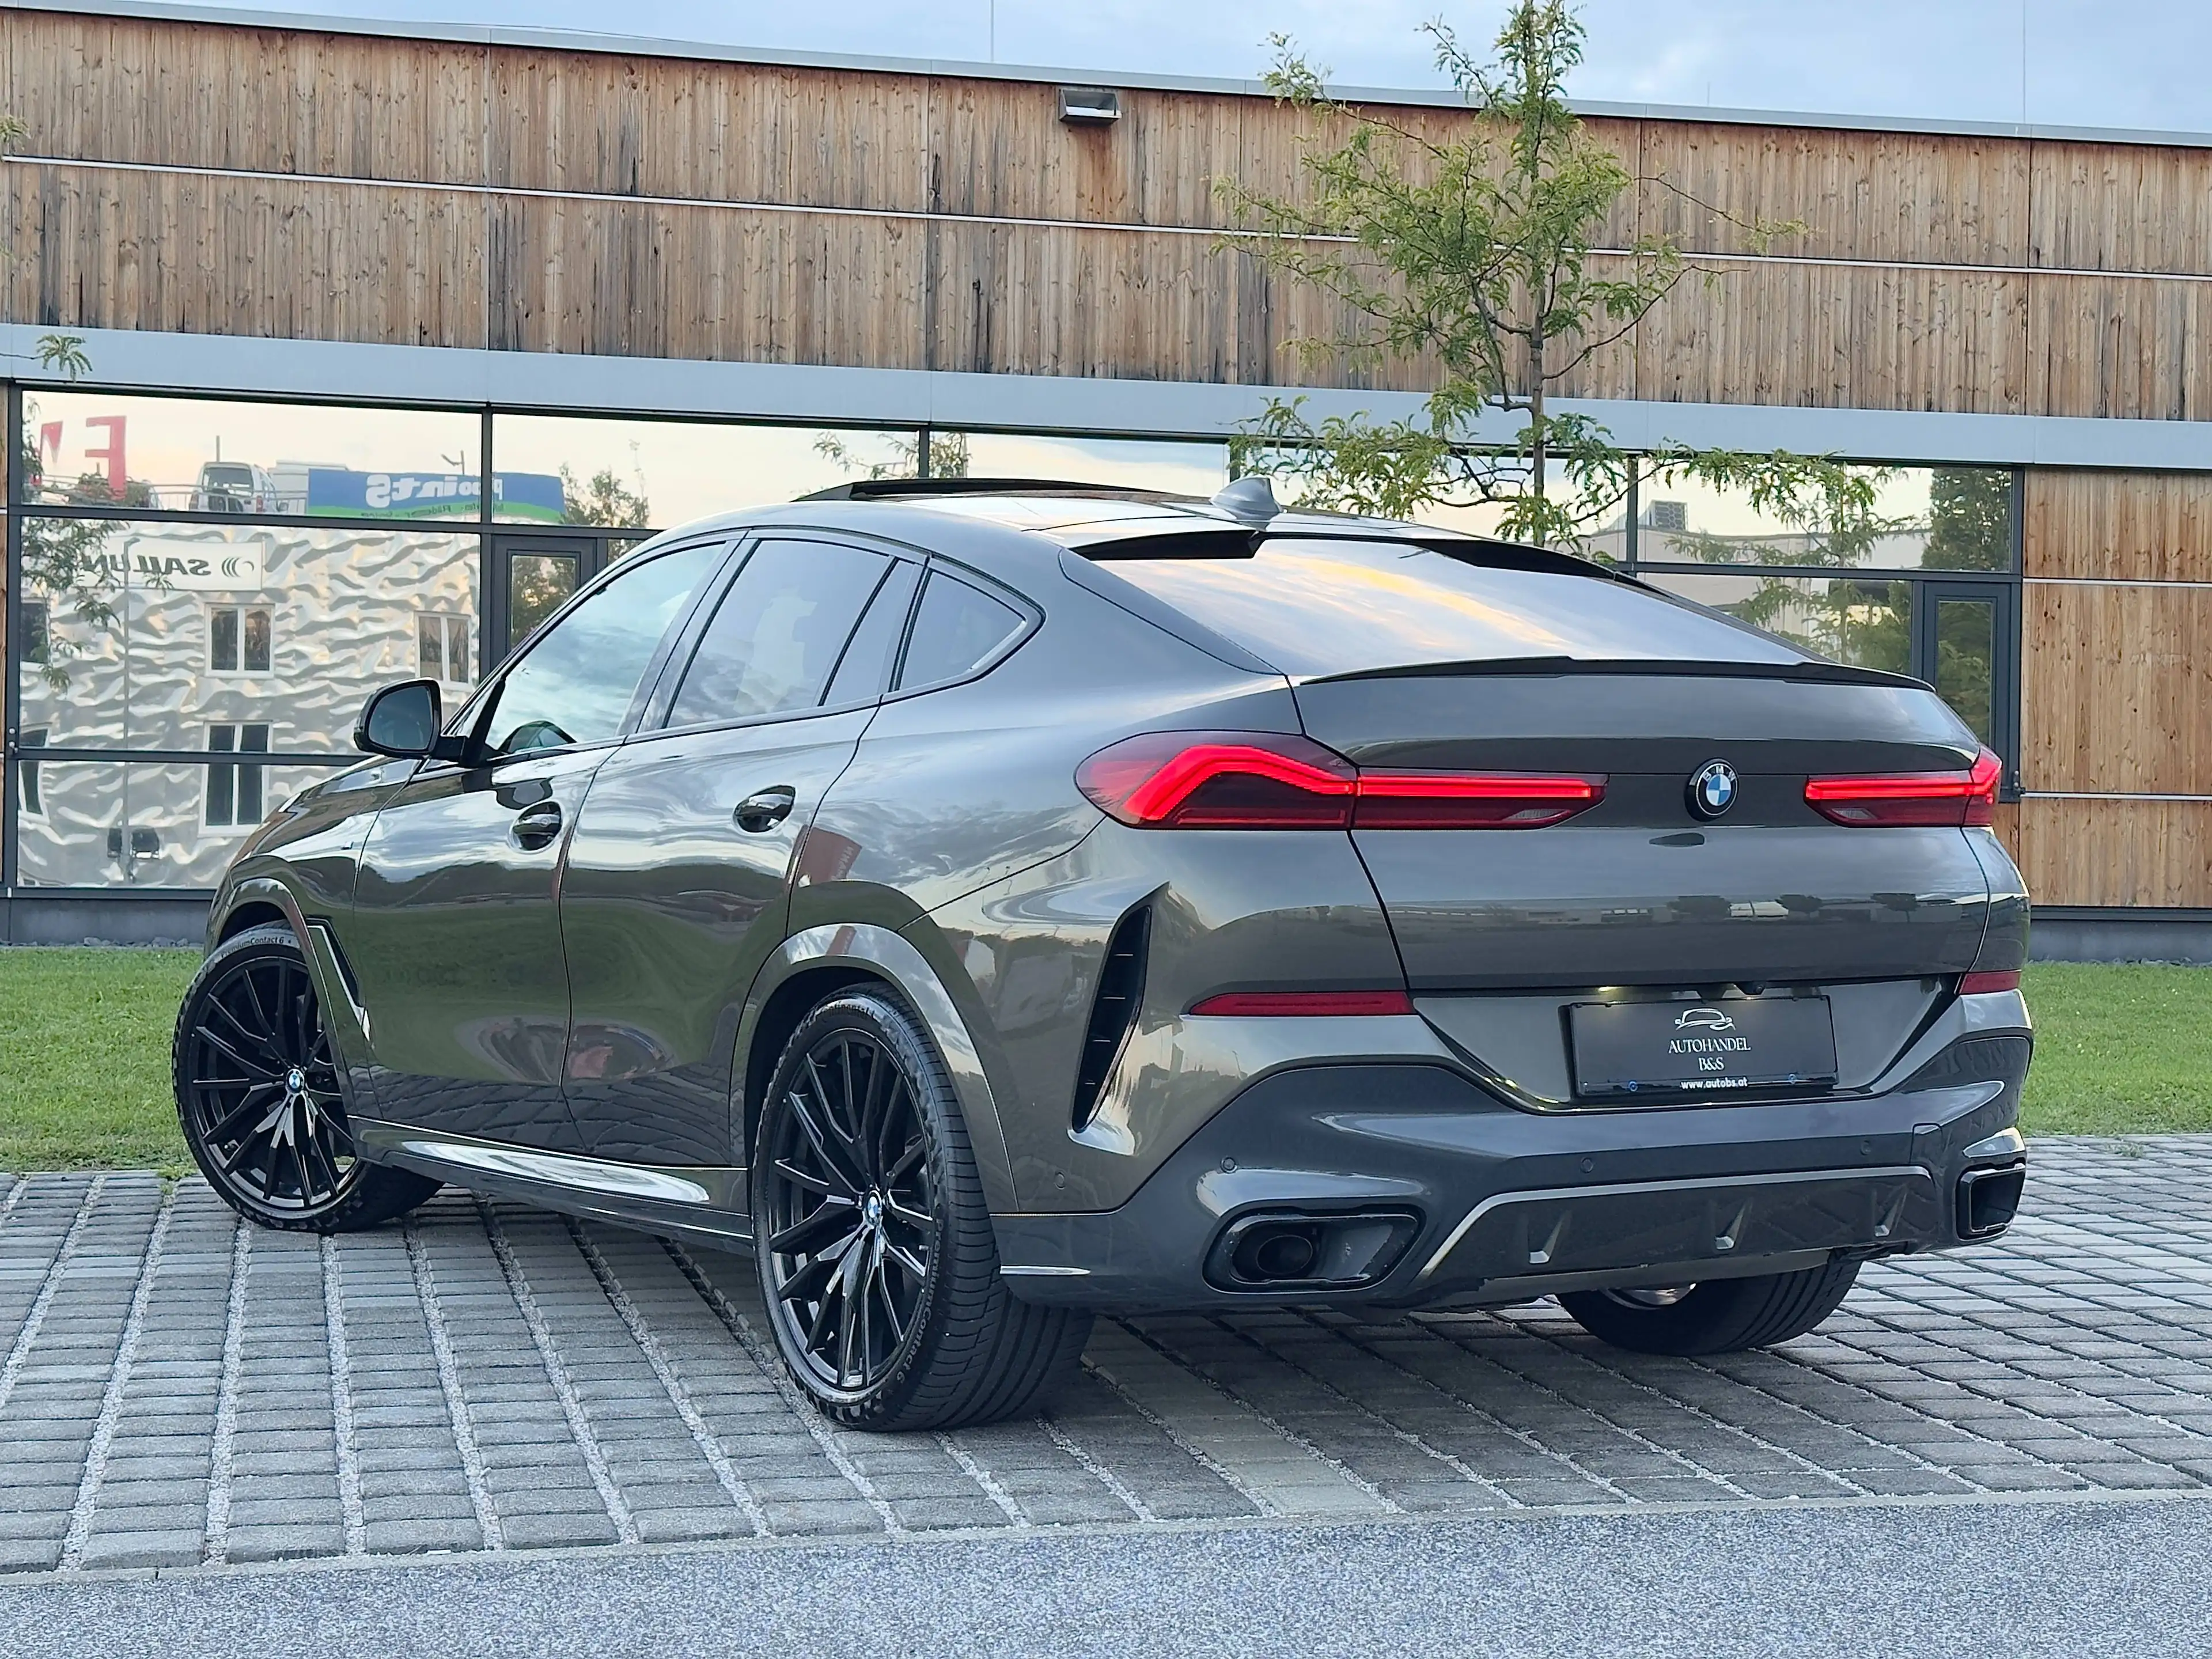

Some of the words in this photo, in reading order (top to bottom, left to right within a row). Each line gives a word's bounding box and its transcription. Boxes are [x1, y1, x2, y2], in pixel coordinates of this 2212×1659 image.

[1702, 765, 1737, 782] BMW
[1668, 1037, 1751, 1054] AUTOHANDEL
[1698, 1056, 1725, 1071] B&S
[1680, 1077, 1748, 1090] www.autobs.at
